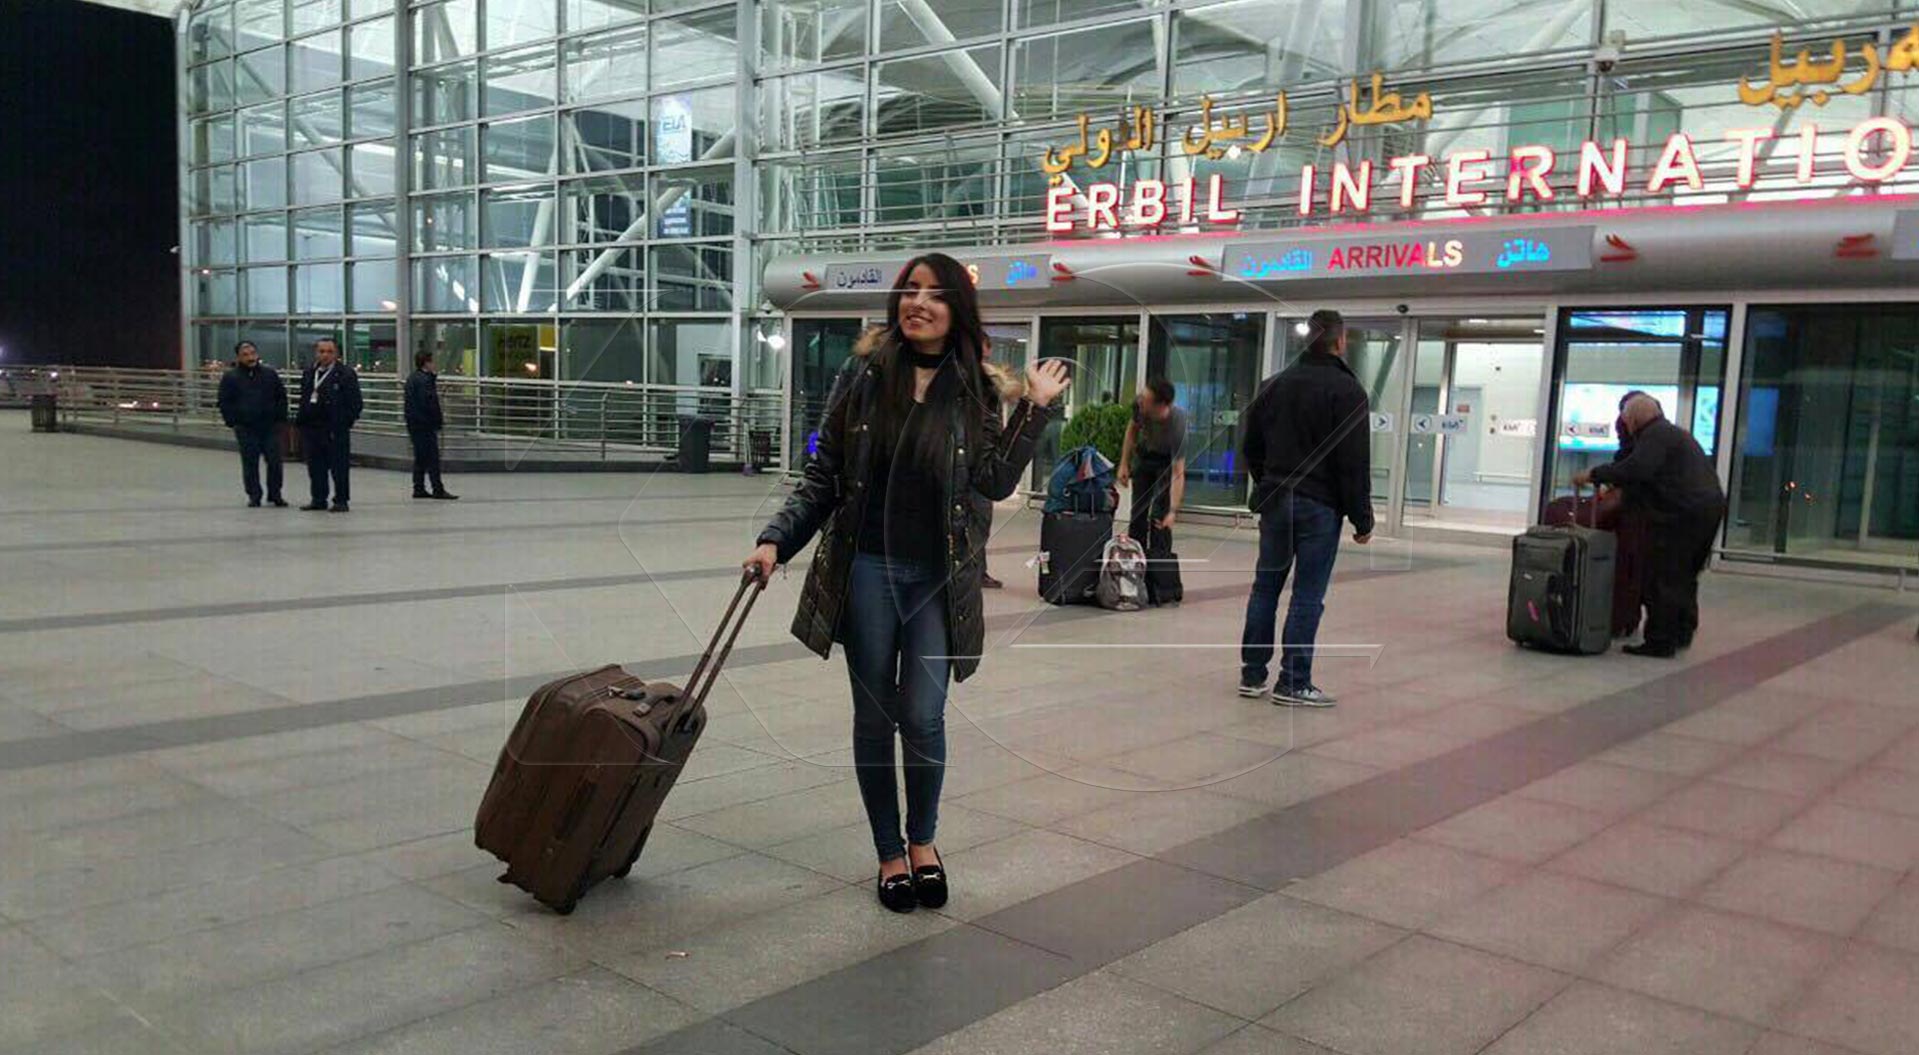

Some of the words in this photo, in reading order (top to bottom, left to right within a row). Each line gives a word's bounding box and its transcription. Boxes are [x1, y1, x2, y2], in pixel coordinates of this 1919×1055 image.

[1041, 104, 1154, 186] الدولي
[1182, 89, 1288, 160] اربيل
[1316, 69, 1434, 147] مطار
[1045, 172, 1240, 232] ERBIL
[1299, 116, 1913, 216] INTERNATIO
[1328, 240, 1463, 271] ARRIVALS
